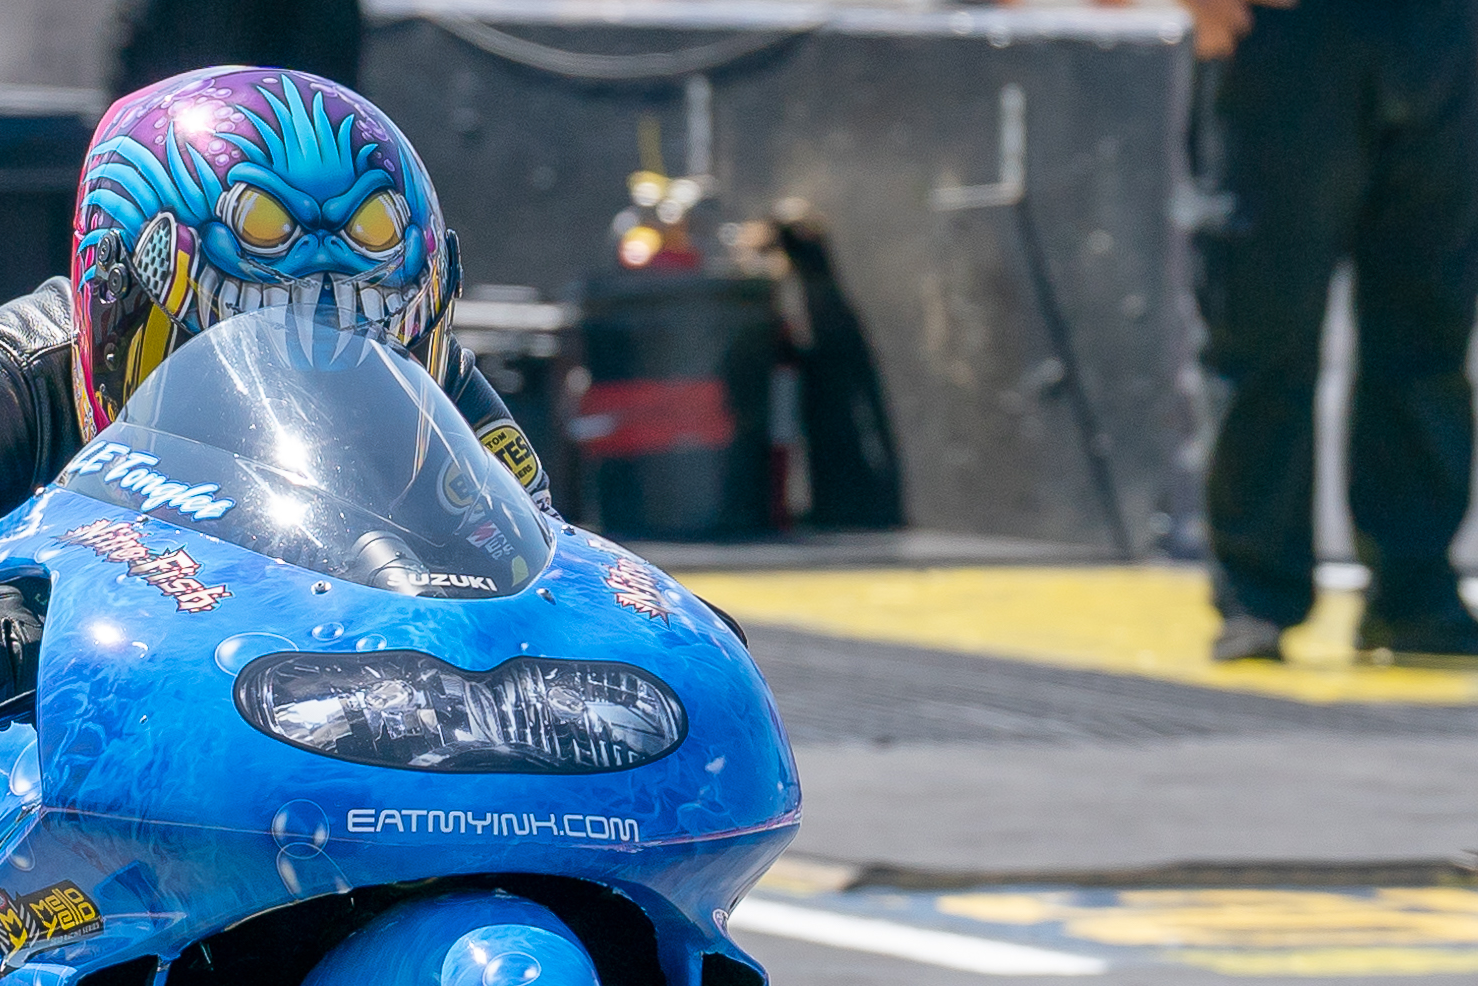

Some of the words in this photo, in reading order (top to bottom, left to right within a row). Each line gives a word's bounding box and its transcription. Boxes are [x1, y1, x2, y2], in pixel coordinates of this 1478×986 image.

[494, 434, 532, 473] TES
[386, 572, 498, 593] SUZUKI
[346, 808, 640, 842] EATMYINK.COM
